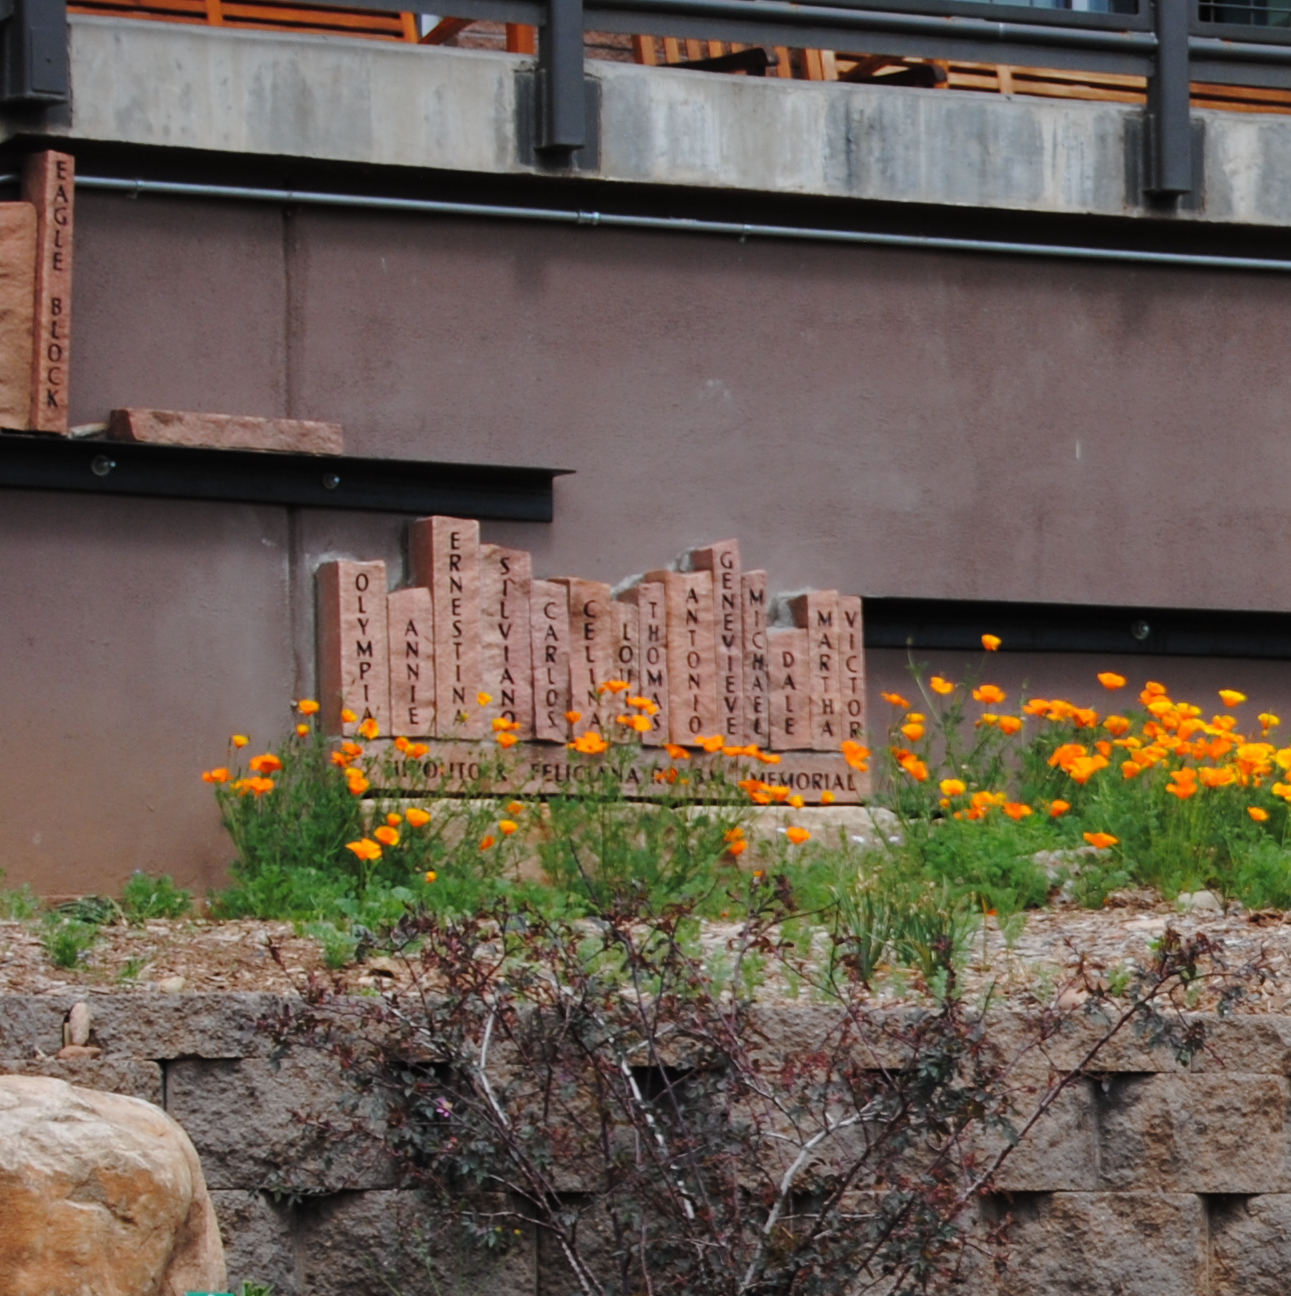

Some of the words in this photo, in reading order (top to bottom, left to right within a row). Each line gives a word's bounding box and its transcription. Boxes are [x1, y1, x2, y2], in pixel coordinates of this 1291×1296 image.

[52, 160, 67, 271] EAGLE
[47, 298, 62, 408] BLOCK
[355, 573, 373, 725] OLYMPIA
[404, 619, 420, 725] ANNIE
[449, 532, 465, 725] ERNESTINA
[498, 557, 516, 723] SILVIANO
[544, 602, 559, 728] CARLOS
[584, 600, 600, 726] CELINA
[647, 601, 662, 732] THOMAS
[686, 587, 701, 734] ANTONIO
[720, 551, 737, 735] GENEVIEVE
[749, 589, 764, 735] MICHAEL
[817, 610, 834, 737] MARTHA
[844, 611, 861, 739] VICTOR
[783, 651, 796, 735] DALE
[751, 771, 856, 792] MEMORIAL
